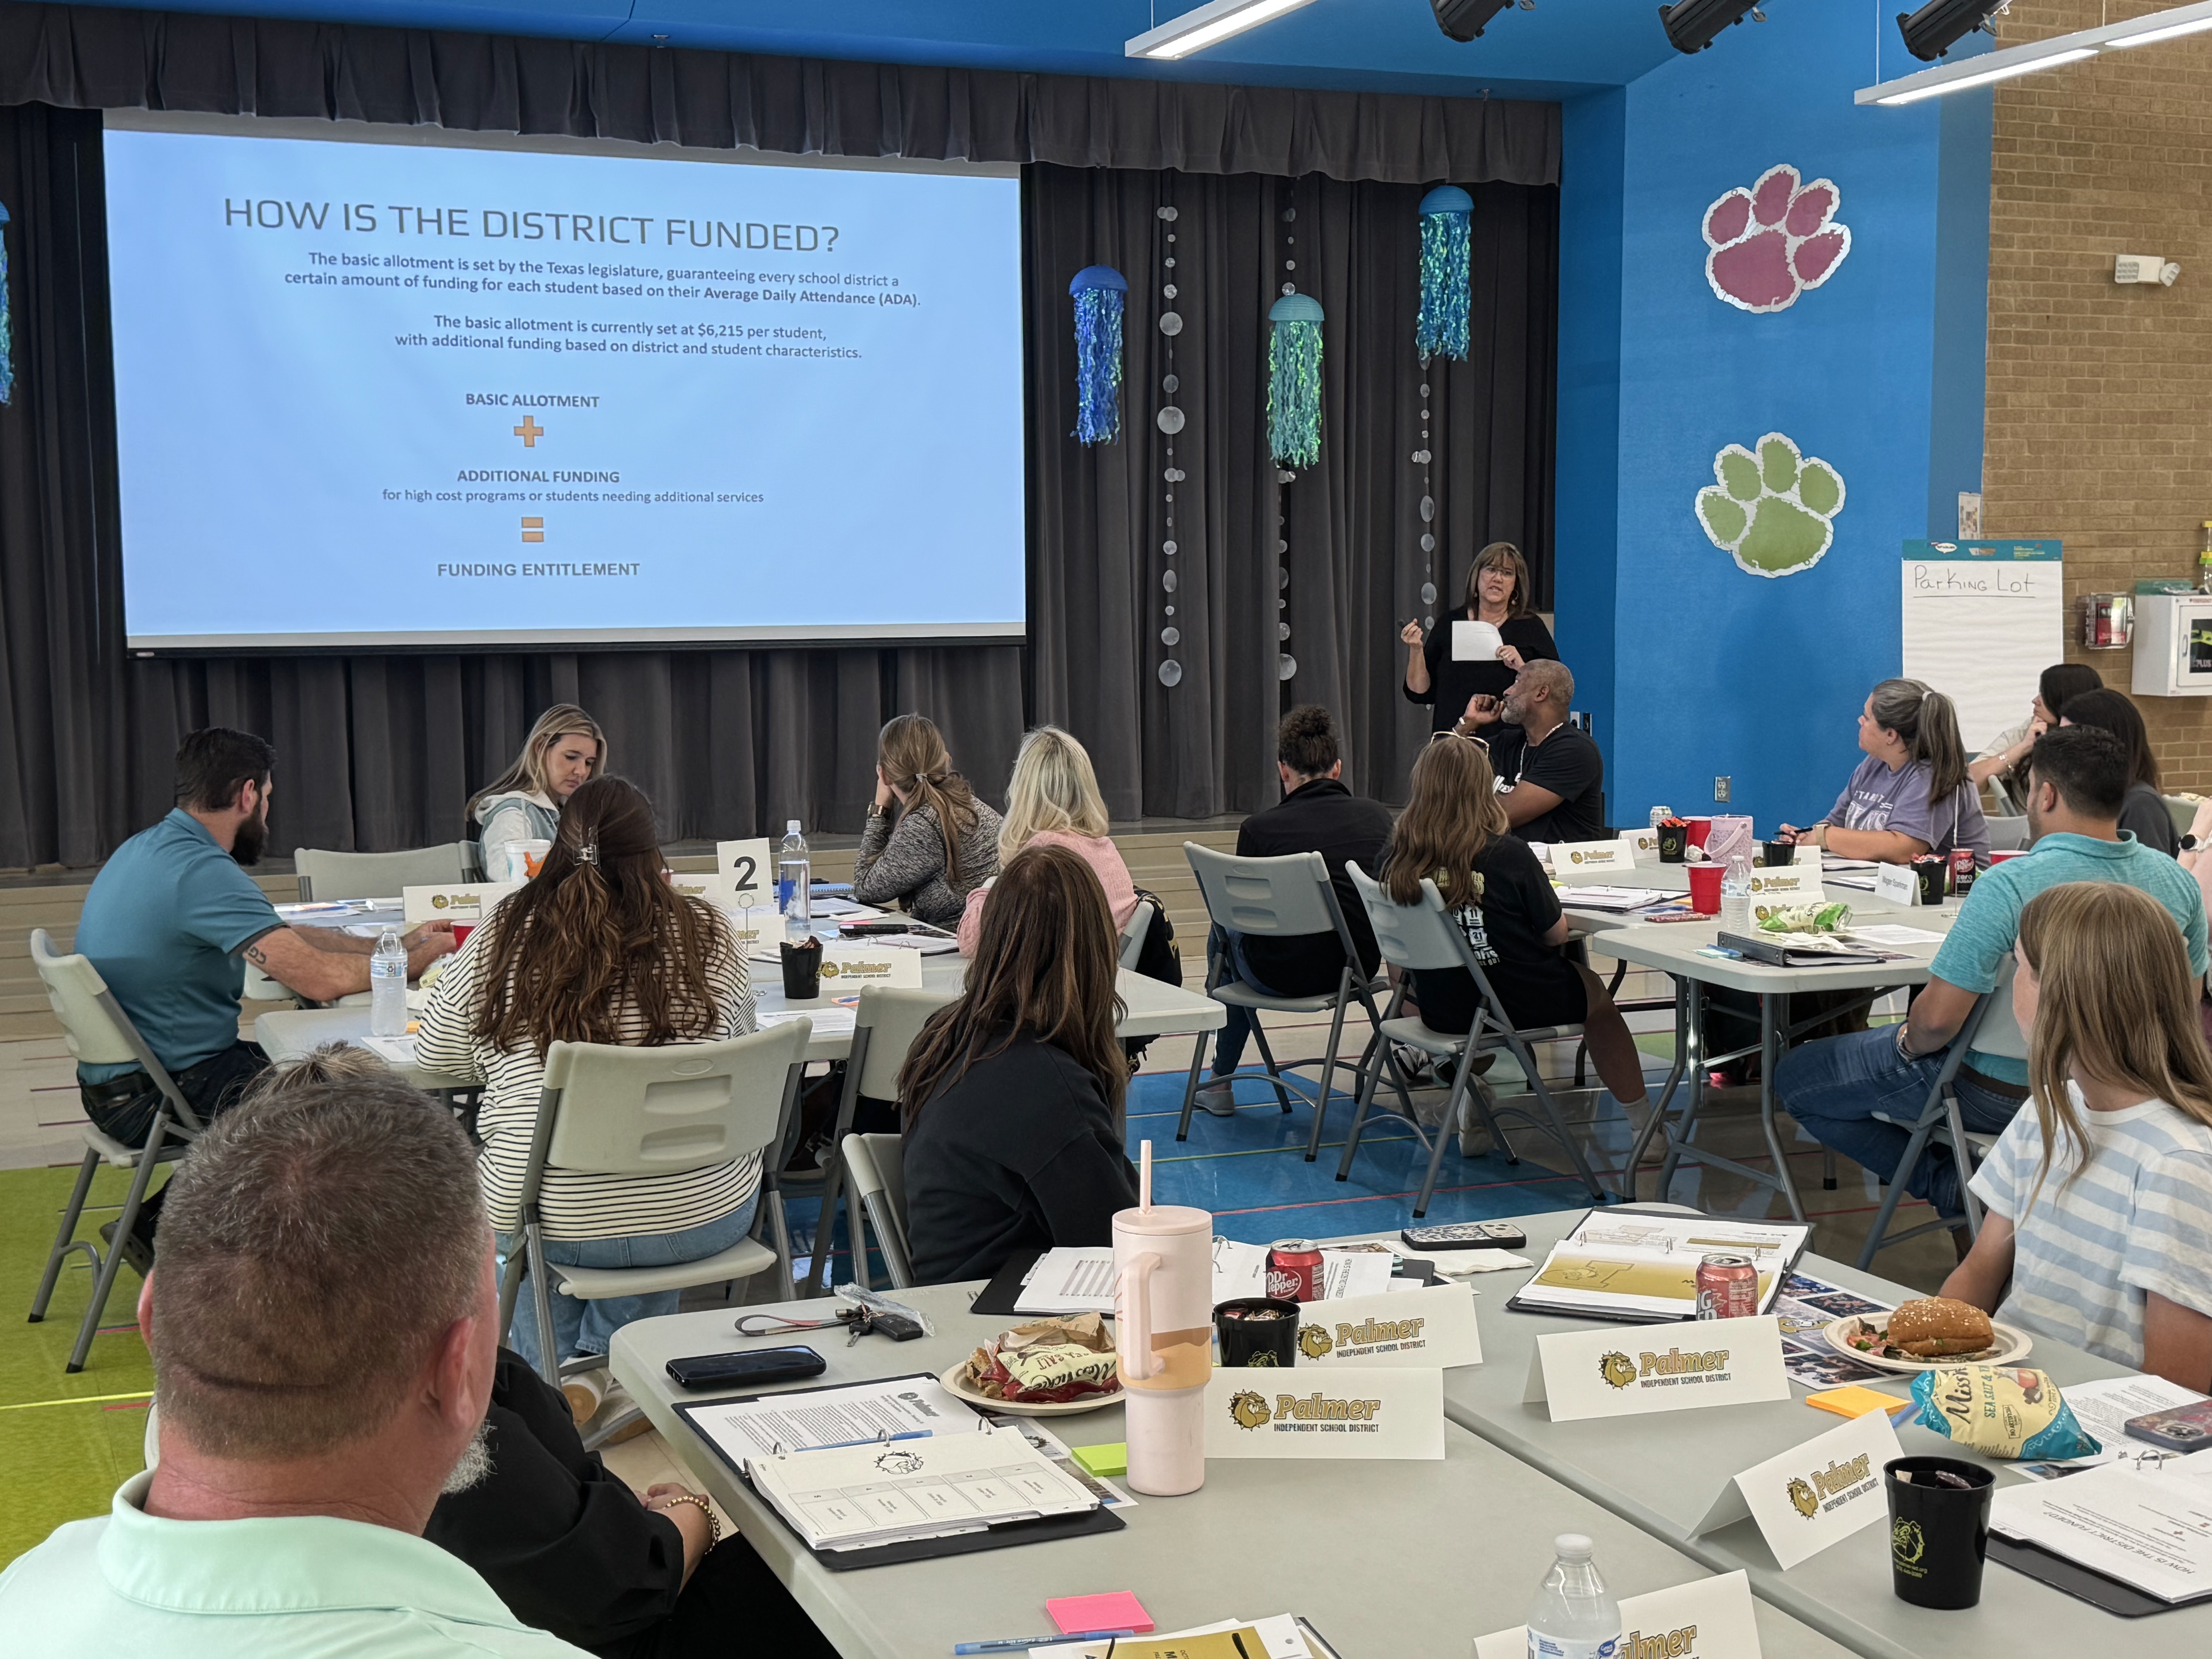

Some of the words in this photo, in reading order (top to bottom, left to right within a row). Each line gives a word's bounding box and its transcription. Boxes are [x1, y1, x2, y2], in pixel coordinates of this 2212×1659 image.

[225, 198, 330, 230] HOW
[343, 203, 377, 232] IS
[388, 205, 470, 236] THE
[483, 210, 654, 244] DISTRICT
[666, 219, 839, 252] FUNDED?
[308, 252, 337, 265] The
[342, 252, 380, 266] basic
[383, 254, 454, 270] allotment
[458, 258, 469, 270] is
[473, 260, 495, 271] set
[498, 259, 516, 275] by
[519, 260, 543, 273] the
[546, 261, 584, 275] Texas
[588, 263, 663, 280] legislature,
[667, 269, 756, 284] guaranteeing
[759, 273, 795, 285] every
[798, 271, 840, 284] school
[844, 273, 888, 286] district
[892, 278, 898, 287] a
[285, 272, 337, 285] certain
[341, 275, 400, 287] amount
[404, 275, 419, 287] of
[422, 275, 479, 293] funding
[481, 277, 503, 291] for
[507, 279, 541, 292] each
[545, 281, 599, 294] student
[602, 282, 642, 296] based
[646, 287, 664, 297] on
[667, 285, 701, 298] their
[704, 287, 759, 302] Average
[763, 289, 797, 304] Daily
[800, 290, 876, 304] Attendance
[879, 292, 921, 308] (ADA).
[433, 315, 461, 328] The
[465, 315, 501, 330] basic
[505, 318, 574, 332] allotment
[577, 319, 588, 332] is
[591, 322, 653, 337] currently
[657, 324, 677, 335] set
[681, 325, 694, 335] at
[698, 323, 744, 338] $6,215
[747, 328, 770, 339] per
[773, 326, 826, 341] student,
[395, 333, 428, 346] with
[432, 334, 503, 349] additional
[507, 336, 562, 353] funding
[565, 338, 606, 351] based
[610, 343, 628, 352] on
[632, 340, 679, 354] district
[682, 342, 707, 354] and
[711, 343, 762, 356] student
[766, 344, 862, 358] characteristics.
[466, 393, 508, 406] BASIC
[512, 394, 600, 408] ALLOTMENT
[457, 470, 550, 483] ADDITIONAL
[553, 471, 620, 483] FUNDING
[382, 489, 402, 500] for
[405, 489, 432, 503] high
[436, 491, 462, 501] cost
[466, 493, 526, 503] programs
[529, 493, 543, 501] or
[546, 490, 599, 501] students
[602, 491, 651, 504] needing
[654, 491, 714, 502] additional
[717, 492, 764, 502] services
[438, 563, 517, 577] FUNDING
[522, 563, 640, 576] ENTITLEMENT
[1997, 568, 2035, 592] Lot
[733, 856, 758, 891] 2
[841, 961, 891, 974] Palmer
[1274, 1271, 1288, 1283] Dr
[1697, 1290, 1712, 1312] IG
[1336, 1317, 1424, 1347] Palmer
[1337, 1346, 1374, 1358] INDEPENDENT
[1376, 1343, 1399, 1353] SCHOOL
[1400, 1340, 1426, 1350] DISTRICT
[1639, 1348, 1729, 1377] Palmer
[1641, 1377, 1679, 1388] INDEPENDENT
[1681, 1375, 1704, 1385] SCHOOL
[1705, 1373, 1731, 1382] DISTRICT
[1982, 1381, 1995, 1400] SALT
[1274, 1393, 1381, 1420] Palmer
[1946, 1376, 1972, 1424] Miss
[1984, 1401, 1996, 1418] SEA
[1274, 1424, 1317, 1432] INDEPENDENT
[1320, 1424, 1347, 1432] SCHOOL
[1349, 1424, 1379, 1432] DISTRICT
[1810, 1453, 1870, 1501] Palmer
[1620, 1625, 1697, 1659] almer
